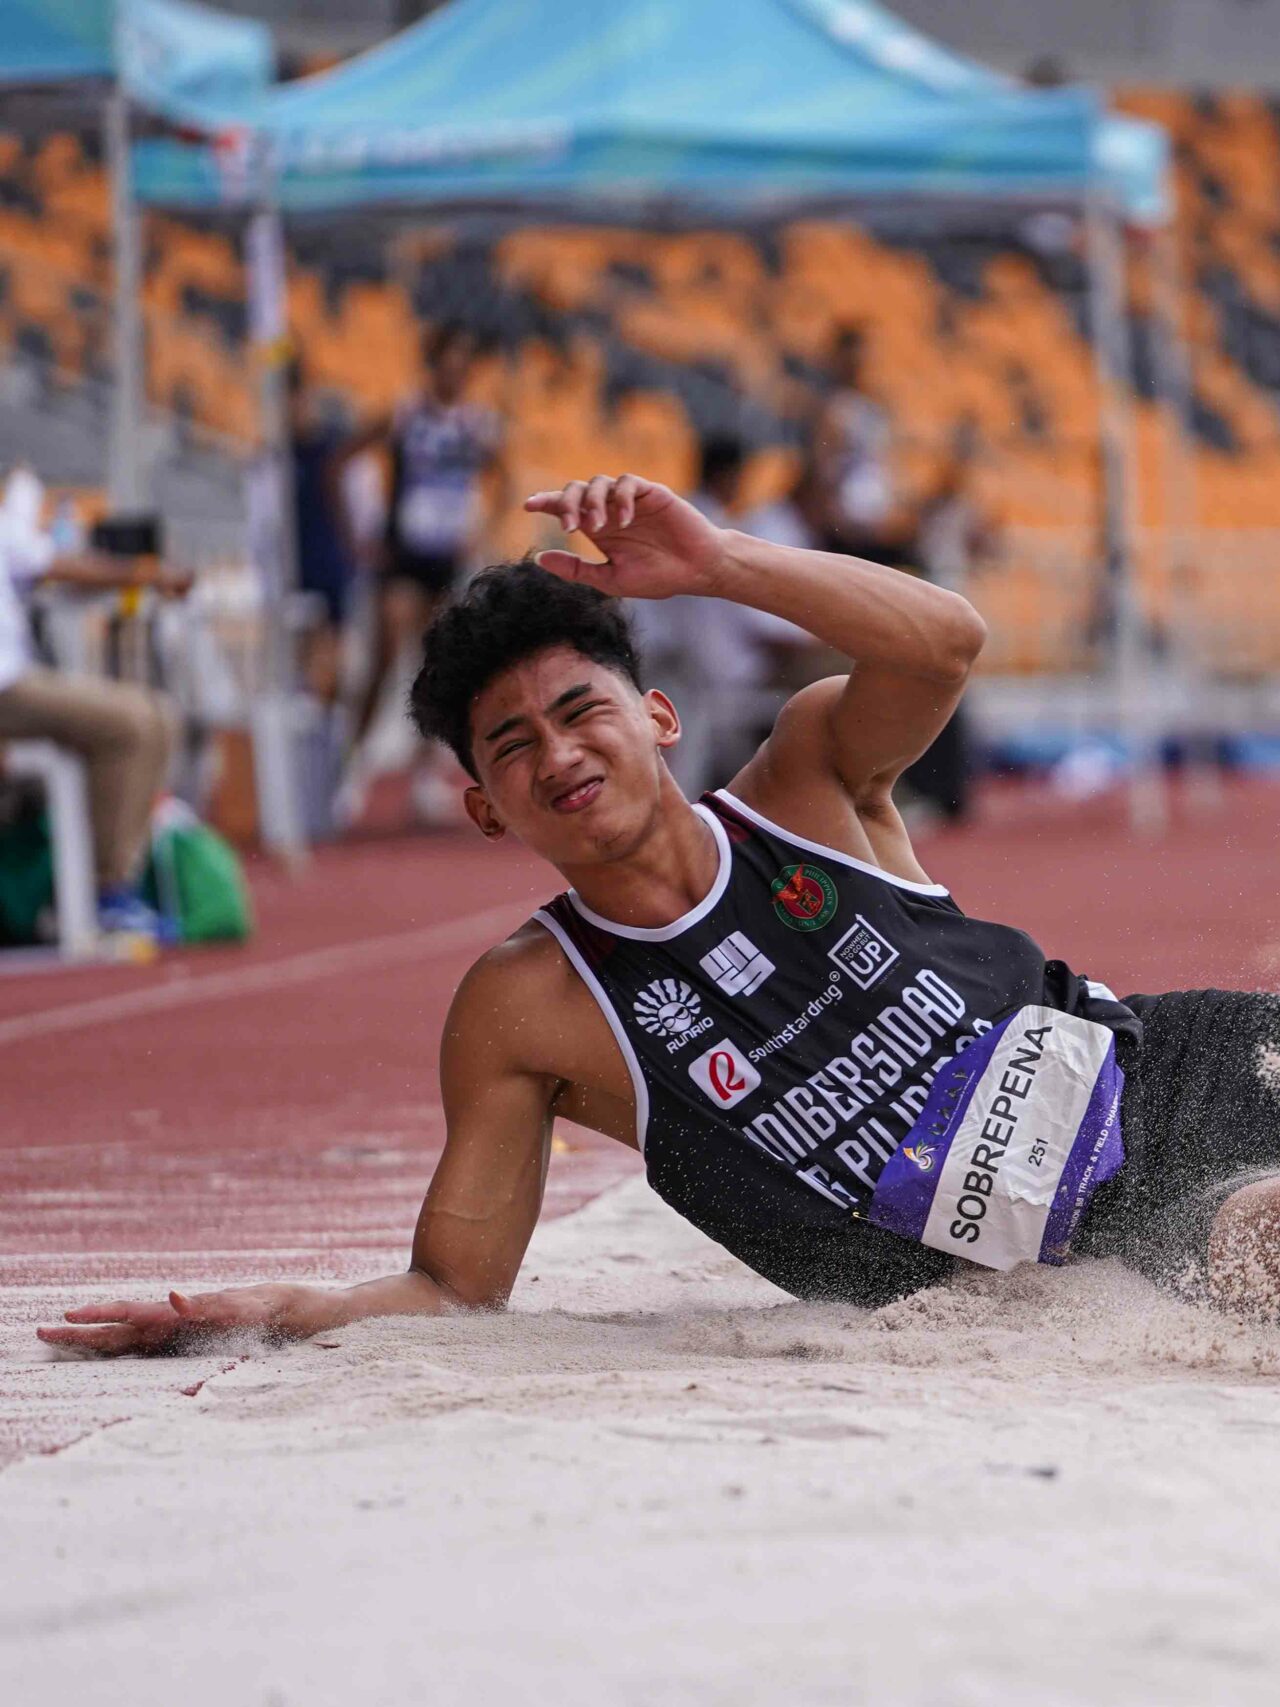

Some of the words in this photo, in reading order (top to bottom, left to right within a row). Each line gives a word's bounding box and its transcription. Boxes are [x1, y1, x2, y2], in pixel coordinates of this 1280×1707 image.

[840, 929, 867, 957] NOWHERE
[845, 952, 854, 961] TO
[852, 944, 861, 954] GO
[860, 933, 871, 946] BUT
[850, 941, 881, 975] UP
[950, 1026, 1053, 1243] SOBREPENA
[1028, 1137, 1048, 1167] 251
[1078, 1164, 1094, 1194] TRACK
[1090, 1153, 1098, 1162] &
[1094, 1129, 1109, 1153] FIELD
